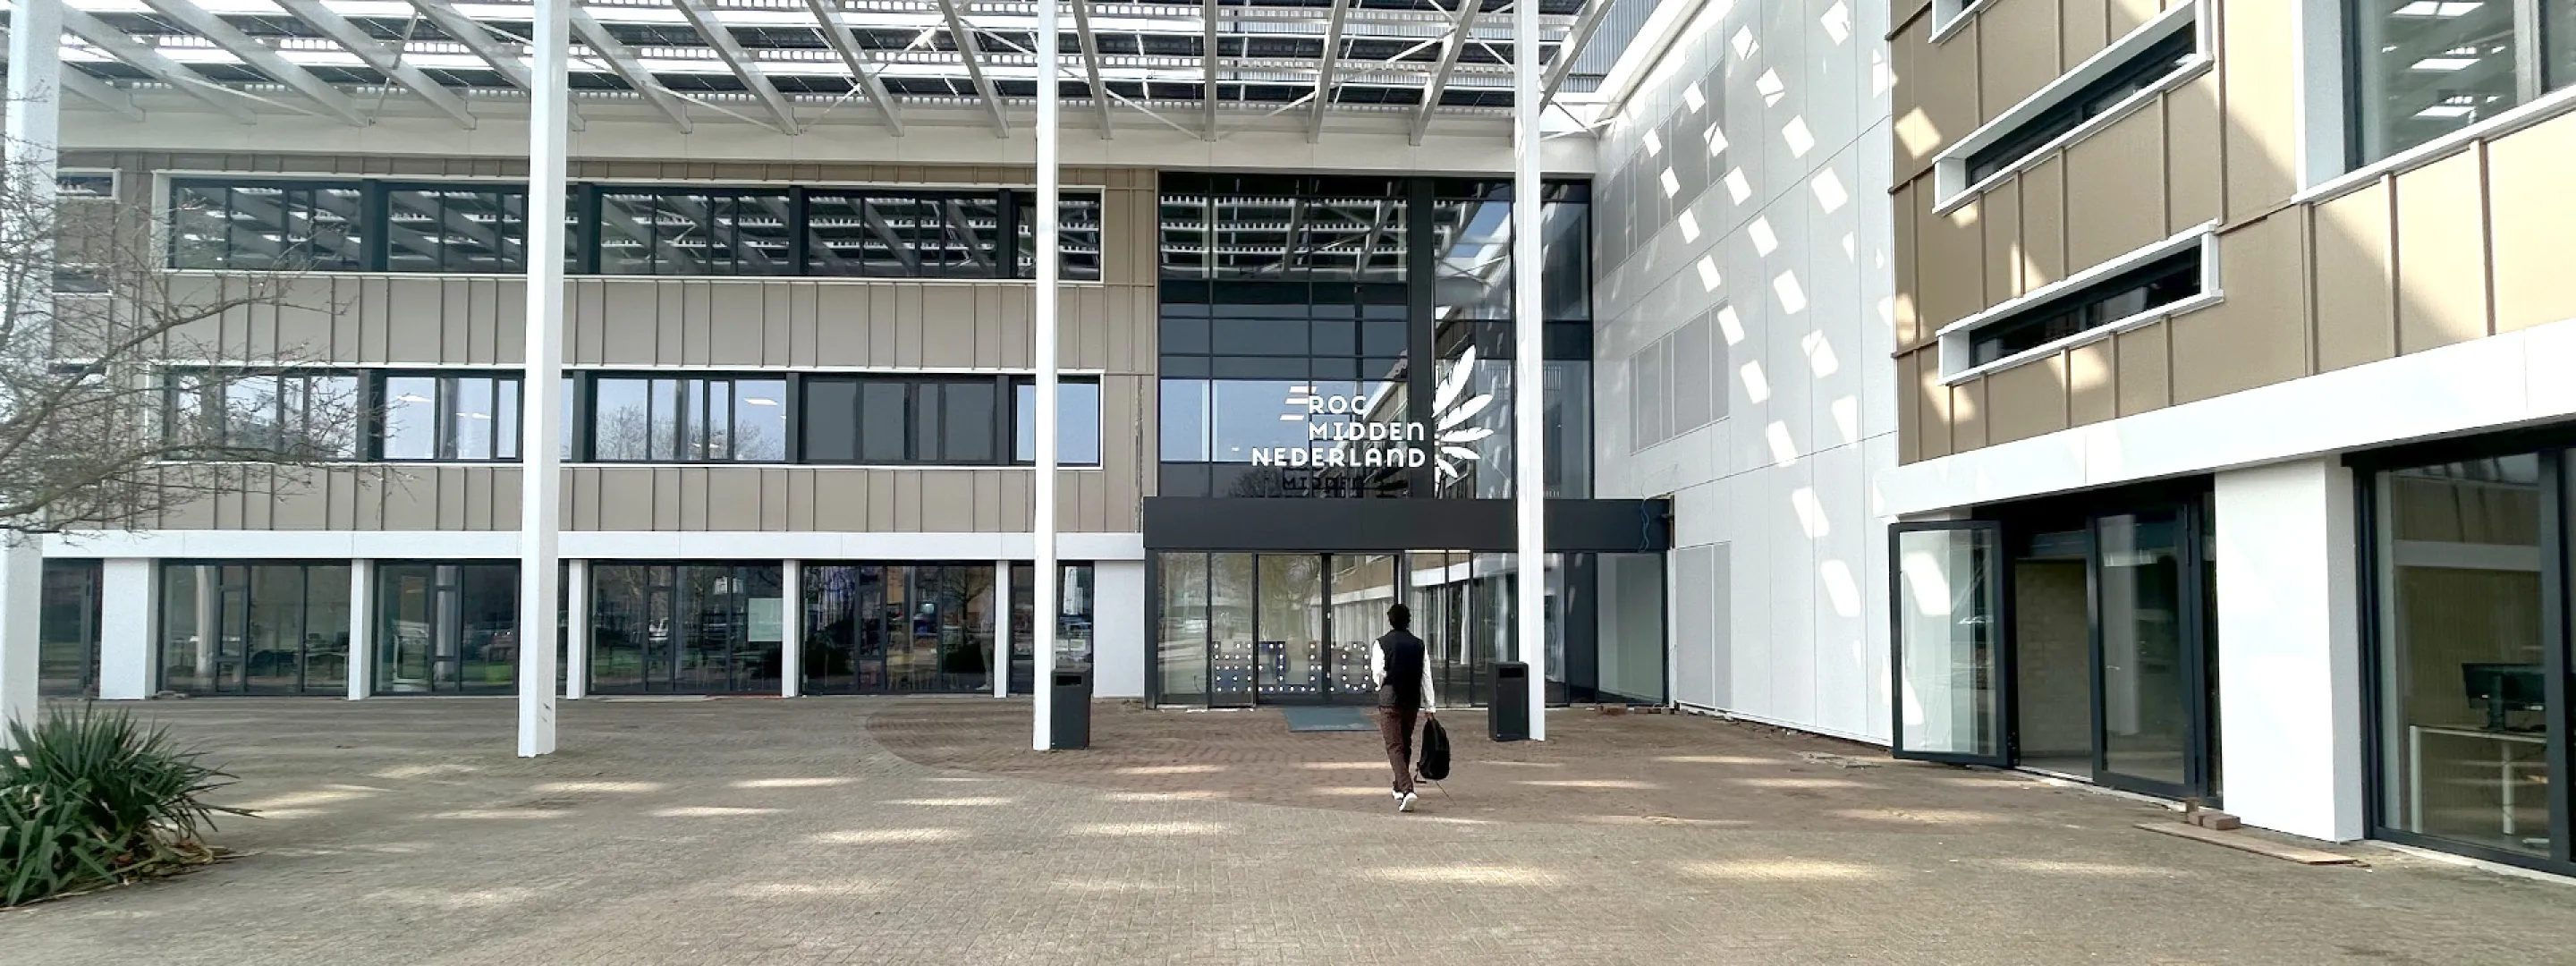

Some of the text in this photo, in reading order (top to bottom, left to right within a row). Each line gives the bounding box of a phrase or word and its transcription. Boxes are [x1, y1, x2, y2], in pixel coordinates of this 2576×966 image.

[1309, 394, 1367, 414] ROC
[1309, 421, 1424, 441] MIDDEN
[1251, 446, 1426, 467] NEDERLAND
